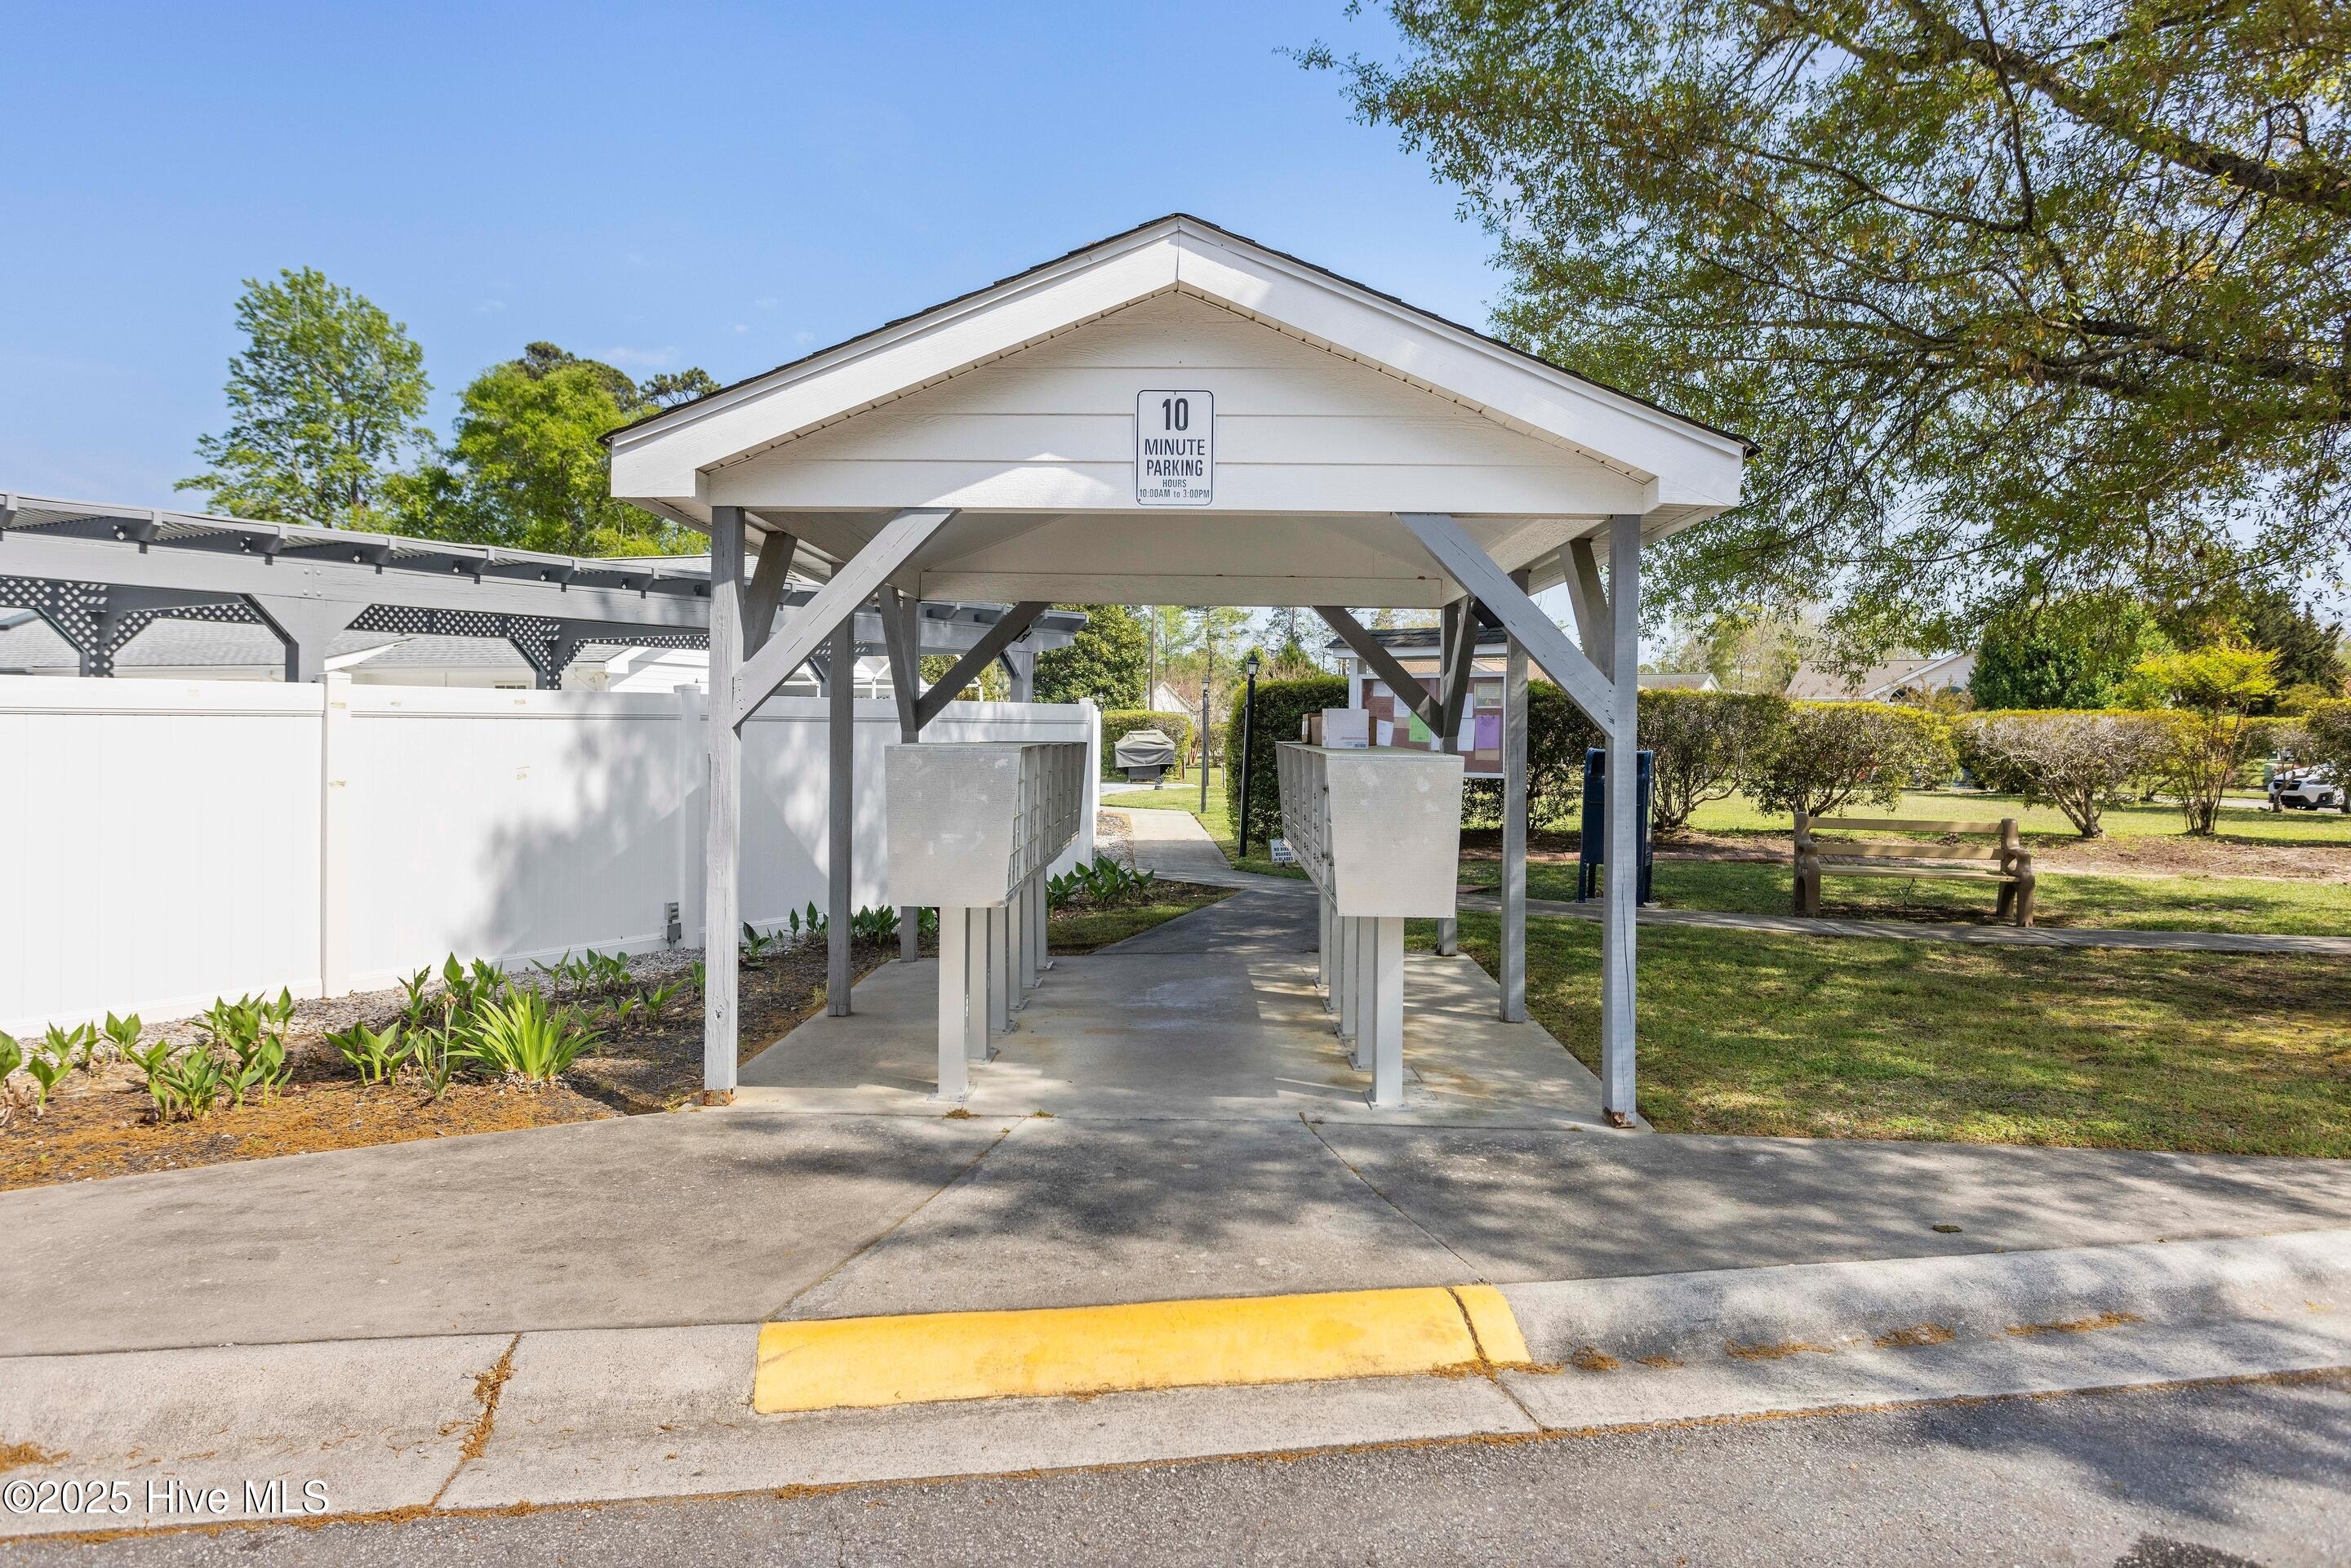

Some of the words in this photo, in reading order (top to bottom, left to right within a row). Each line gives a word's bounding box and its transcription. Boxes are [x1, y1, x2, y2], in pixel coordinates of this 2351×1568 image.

[1162, 398, 1189, 431] 10
[1144, 438, 1206, 455] MINUTE
[1146, 460, 1203, 477] PARKING
[1162, 479, 1187, 488] HOURS
[1140, 489, 1171, 498] 10:00AM
[1183, 489, 1210, 498] 3:00PM
